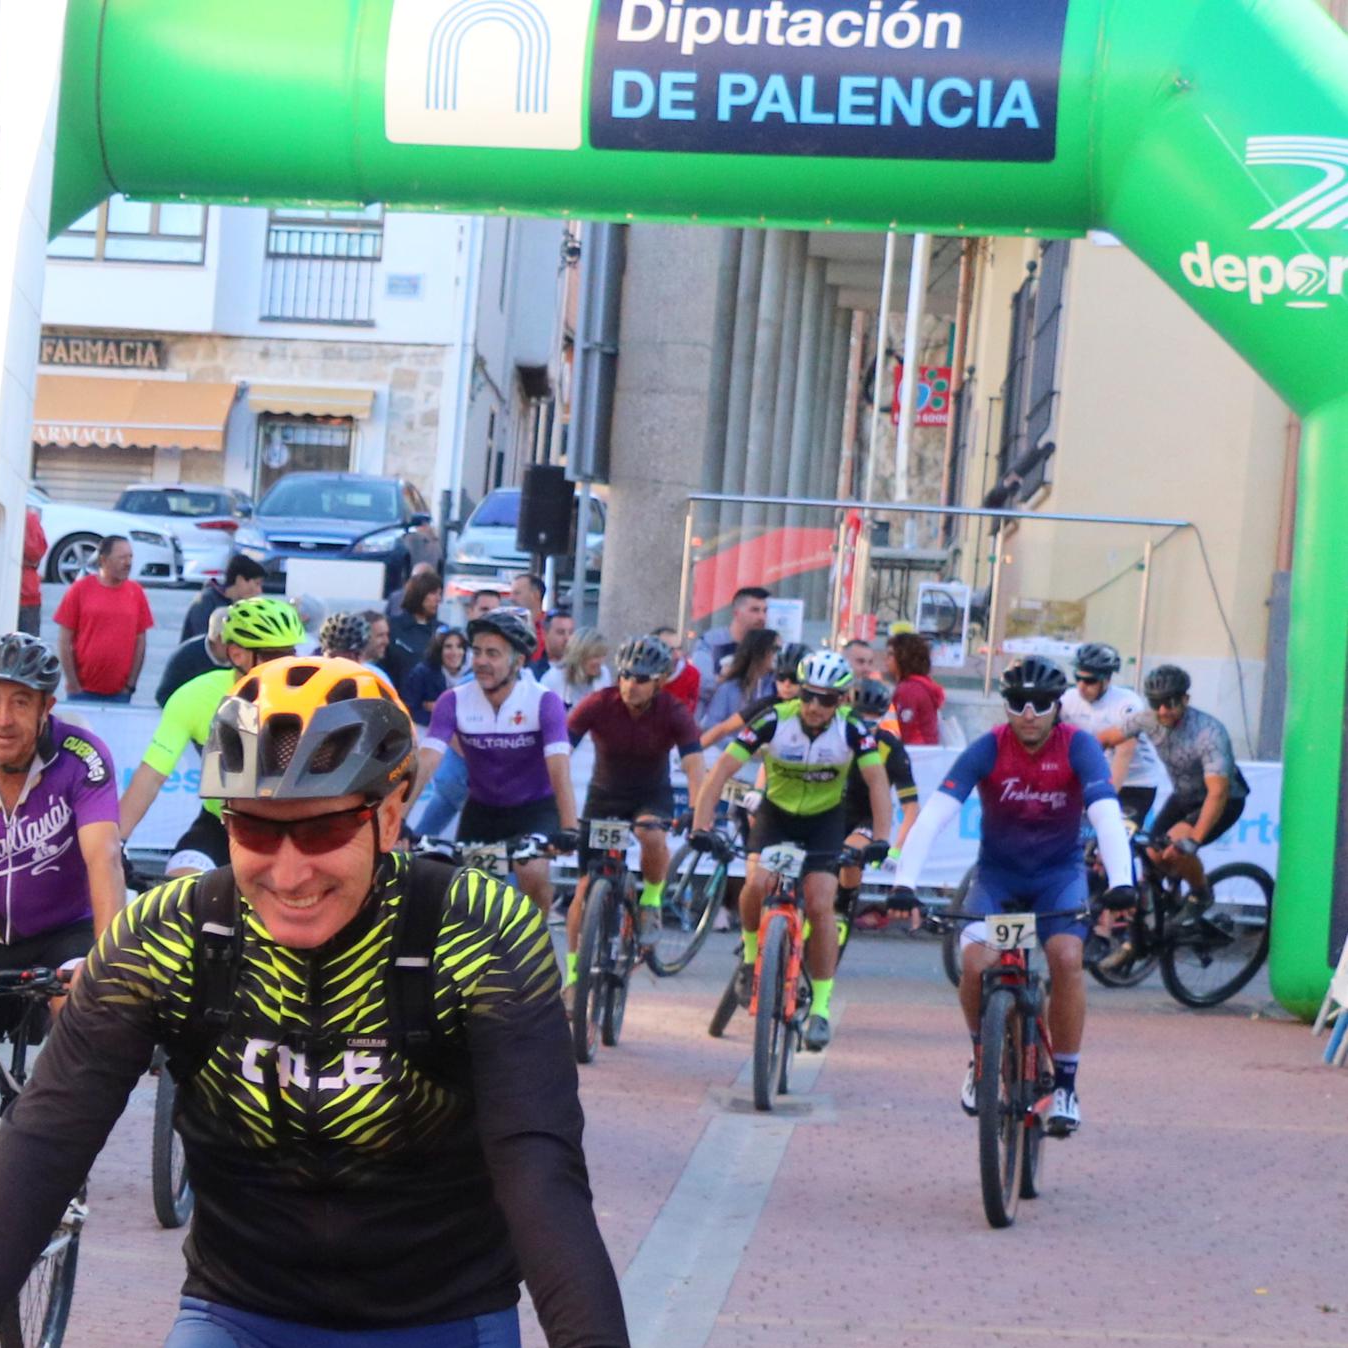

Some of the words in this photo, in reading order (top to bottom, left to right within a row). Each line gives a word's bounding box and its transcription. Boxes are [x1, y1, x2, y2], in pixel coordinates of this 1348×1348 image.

[617, 0, 962, 55] Diputación
[611, 70, 696, 120] DE
[717, 74, 1039, 129] PALENCIA
[41, 339, 159, 366] FARMACIA
[33, 426, 124, 443] ARMACIA
[598, 829, 621, 845] 55
[769, 851, 795, 870] 42
[996, 923, 1026, 947] 97
